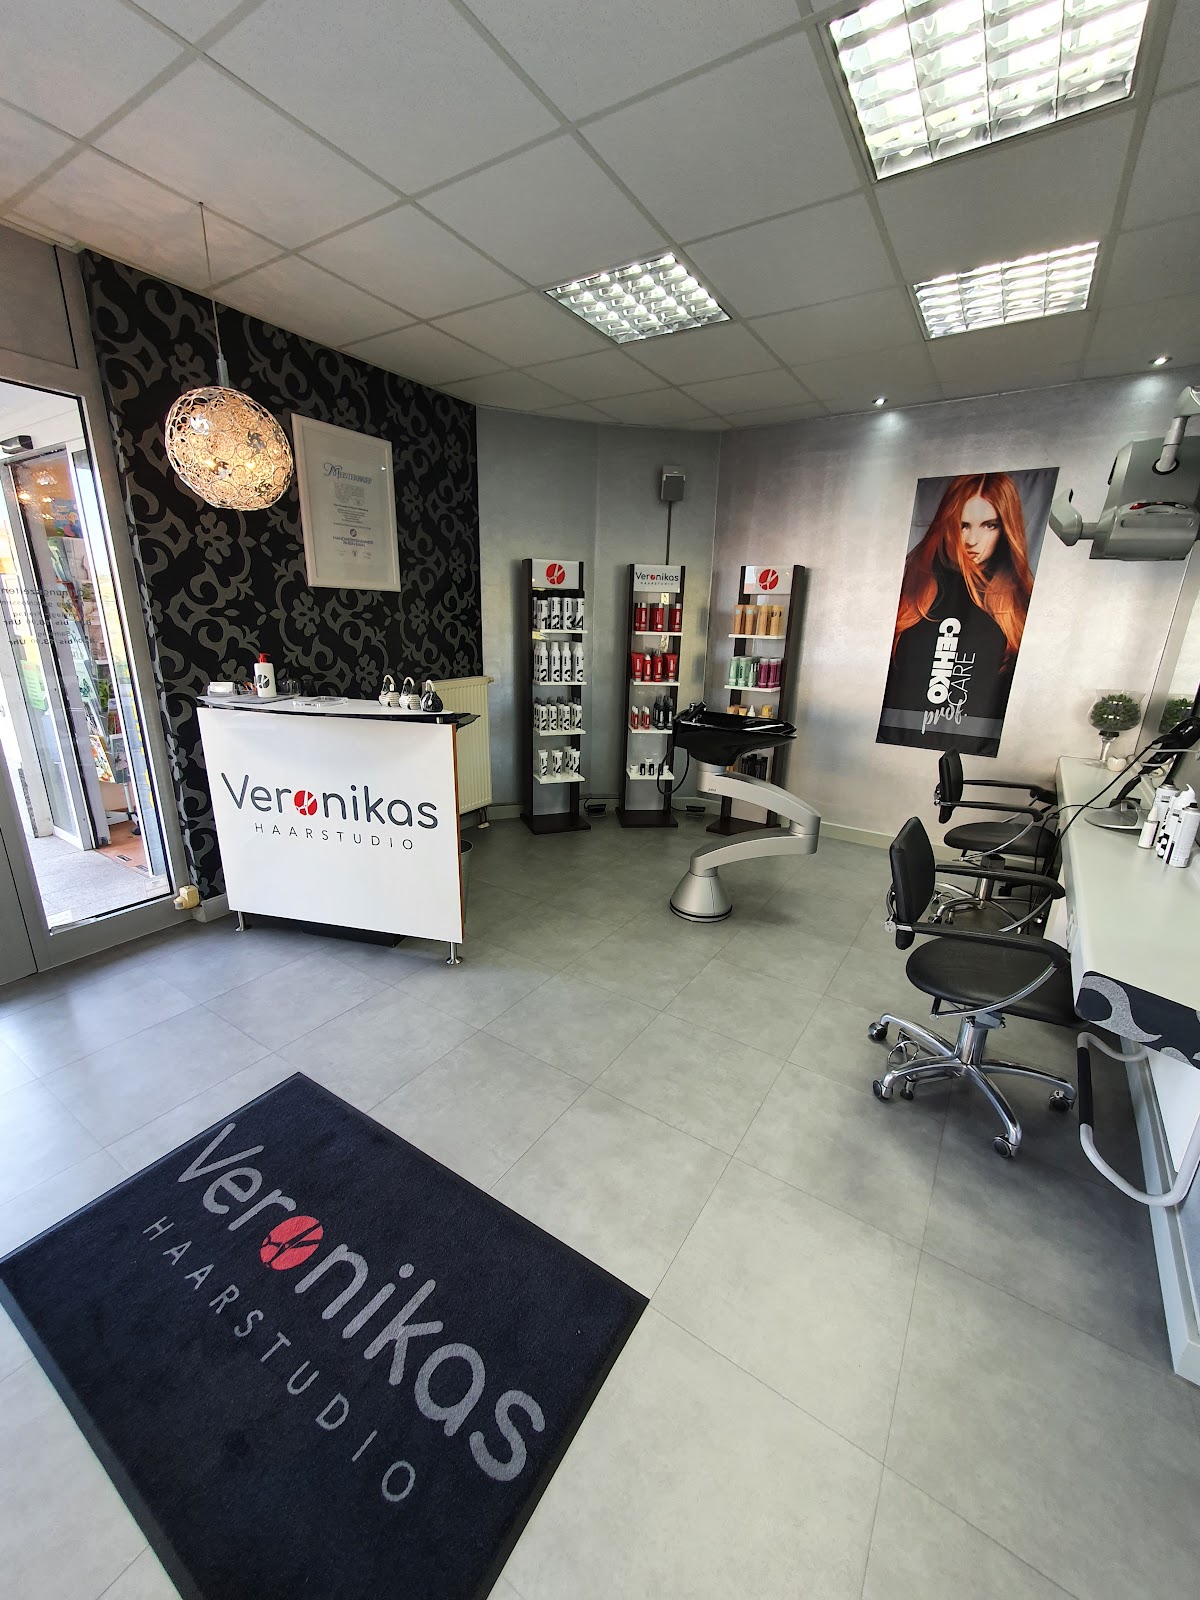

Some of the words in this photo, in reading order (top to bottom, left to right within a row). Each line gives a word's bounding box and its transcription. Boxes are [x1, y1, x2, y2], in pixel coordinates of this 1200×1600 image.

[635, 571, 679, 582] Veronikas
[540, 668, 548, 682] 2
[947, 652, 976, 706] CARE
[921, 698, 968, 735] prof.
[221, 772, 438, 829] Veronikas
[255, 822, 414, 850] HAARSTUDIO
[178, 1122, 546, 1482] Veronikas
[142, 1216, 416, 1502] HAARSTUDIO
